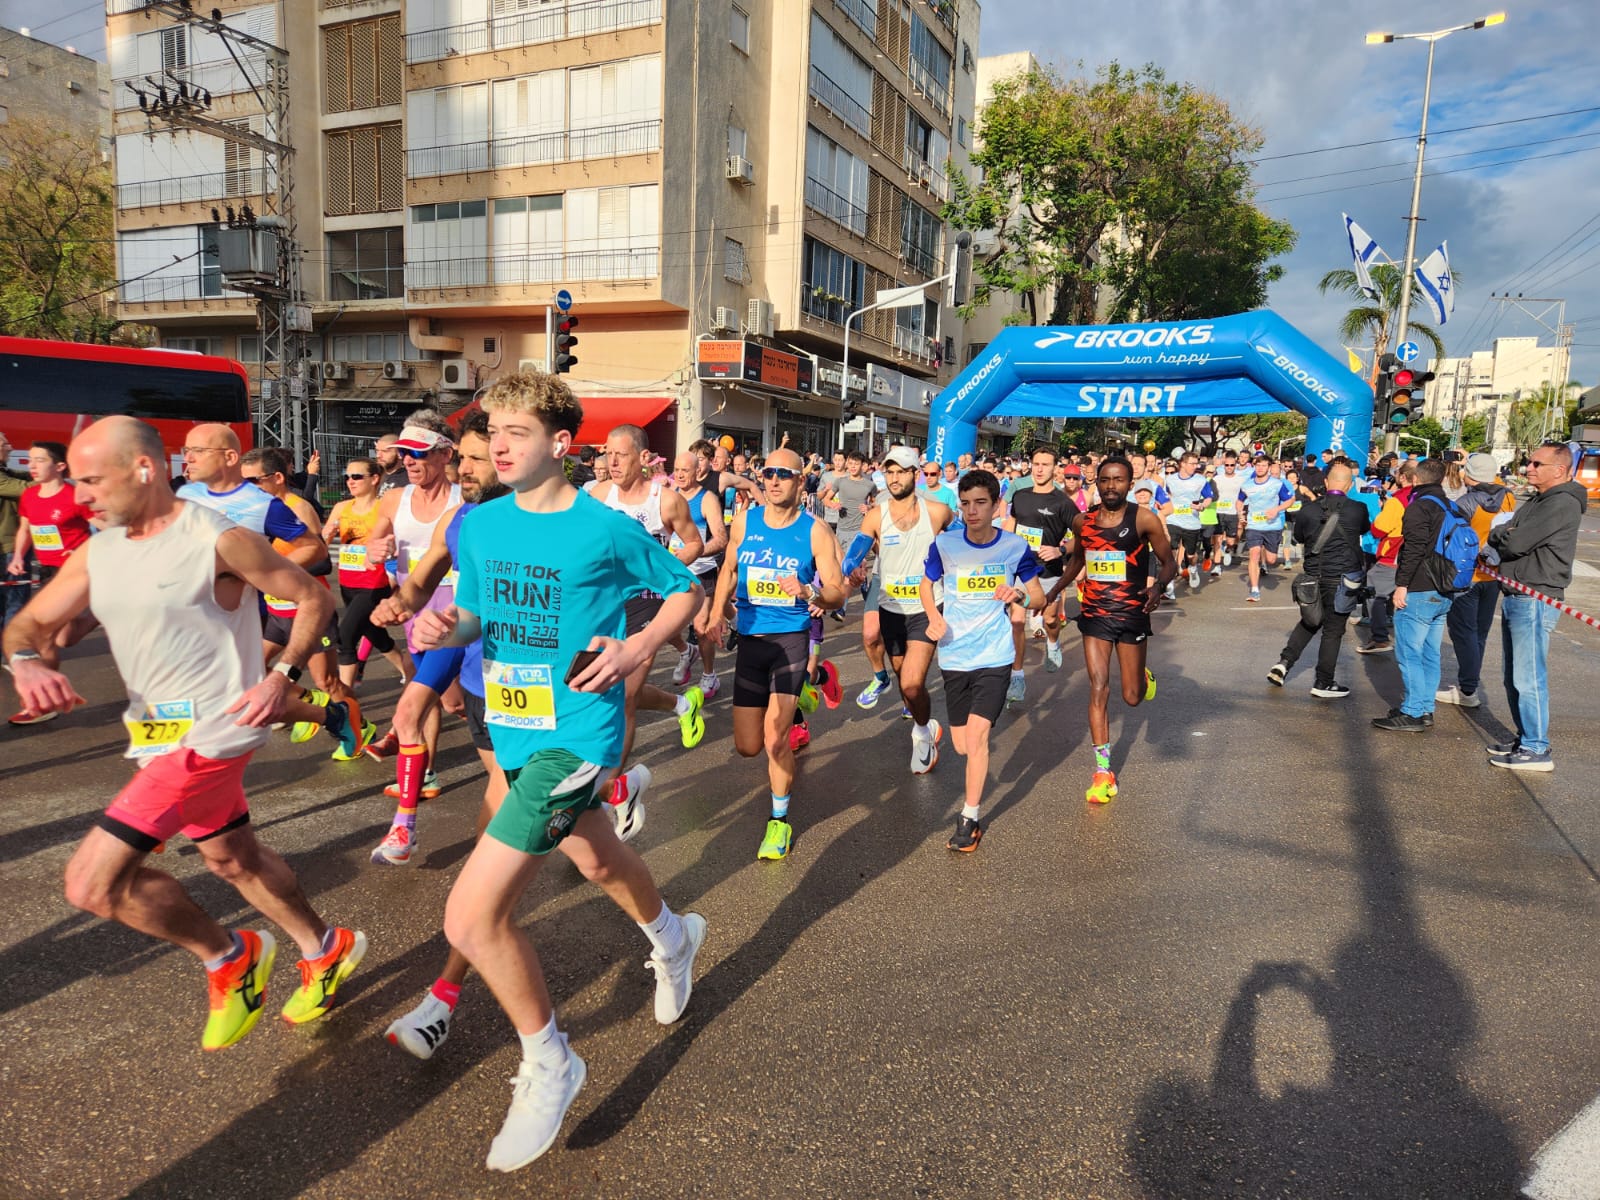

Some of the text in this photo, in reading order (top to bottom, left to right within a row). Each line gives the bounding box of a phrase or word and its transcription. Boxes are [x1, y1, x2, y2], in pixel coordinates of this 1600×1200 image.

[1074, 325, 1214, 348] BROOKS
[1122, 352, 1210, 365] run happy
[957, 353, 1002, 400] BROOKS
[1273, 355, 1338, 403] BROOKS
[1077, 385, 1186, 413] START
[485, 560, 562, 582] START 10K
[1093, 562, 1116, 572] 151
[893, 586, 917, 596] 414
[967, 577, 997, 589] 626
[493, 578, 551, 611] RUN
[552, 586, 562, 611] 2017
[517, 611, 560, 625] דופק
[532, 625, 559, 640] קצב
[501, 688, 527, 709] 90
[505, 715, 544, 727] BROOKS
[142, 722, 180, 740] 273
